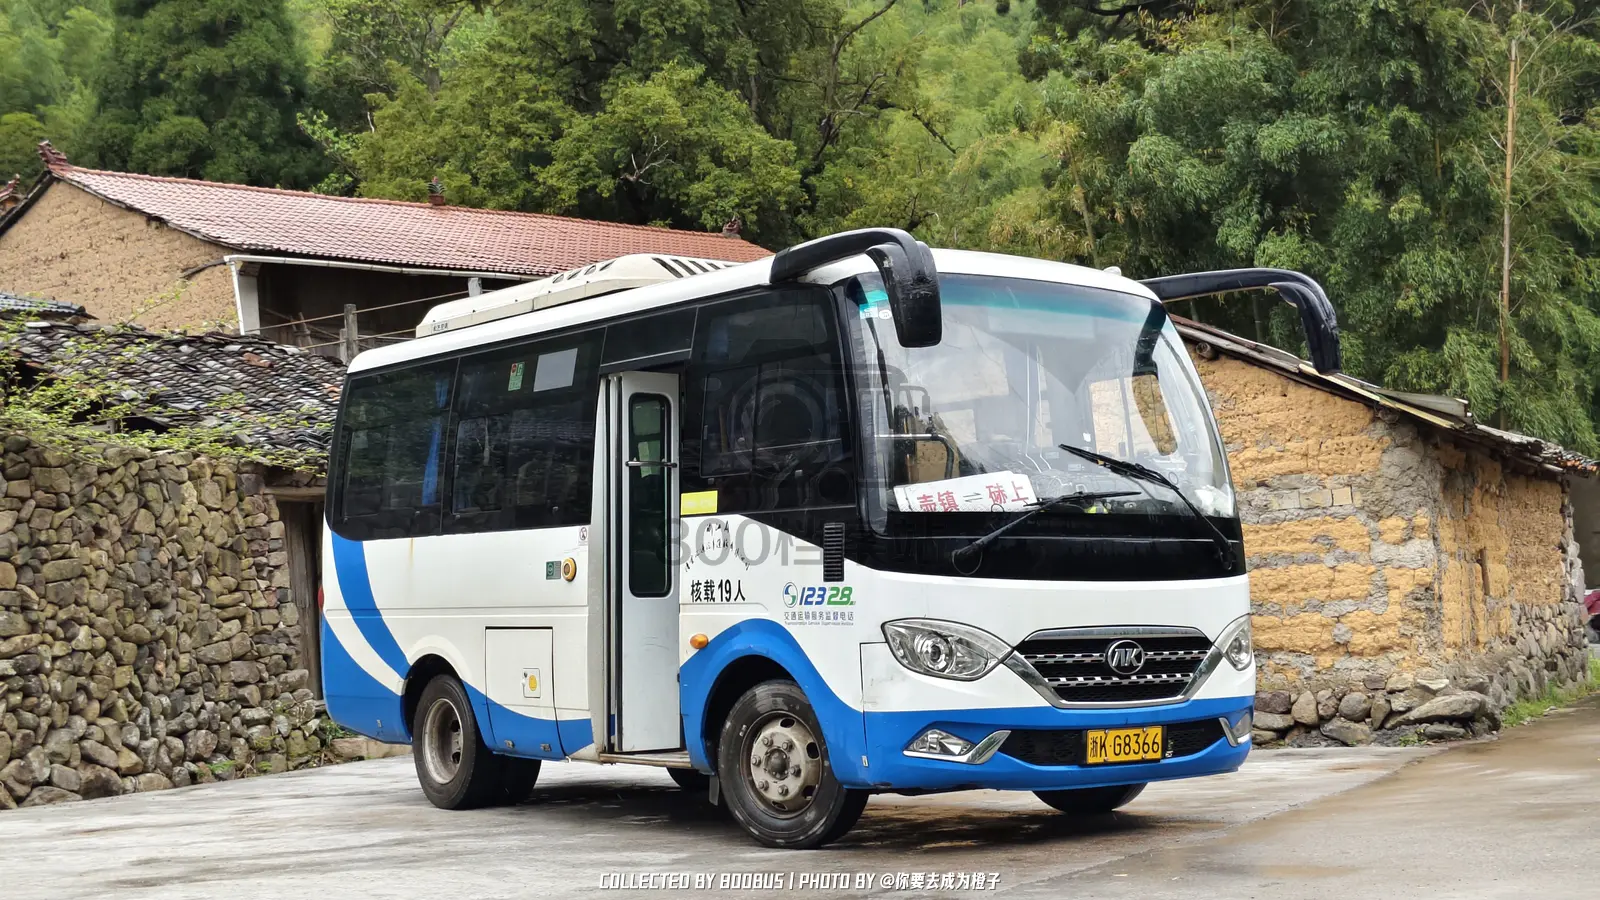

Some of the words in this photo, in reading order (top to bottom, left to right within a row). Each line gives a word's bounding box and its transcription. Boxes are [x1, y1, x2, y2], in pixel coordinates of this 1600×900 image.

[691, 580, 746, 602] 核载19人
[799, 586, 854, 605] 12328
